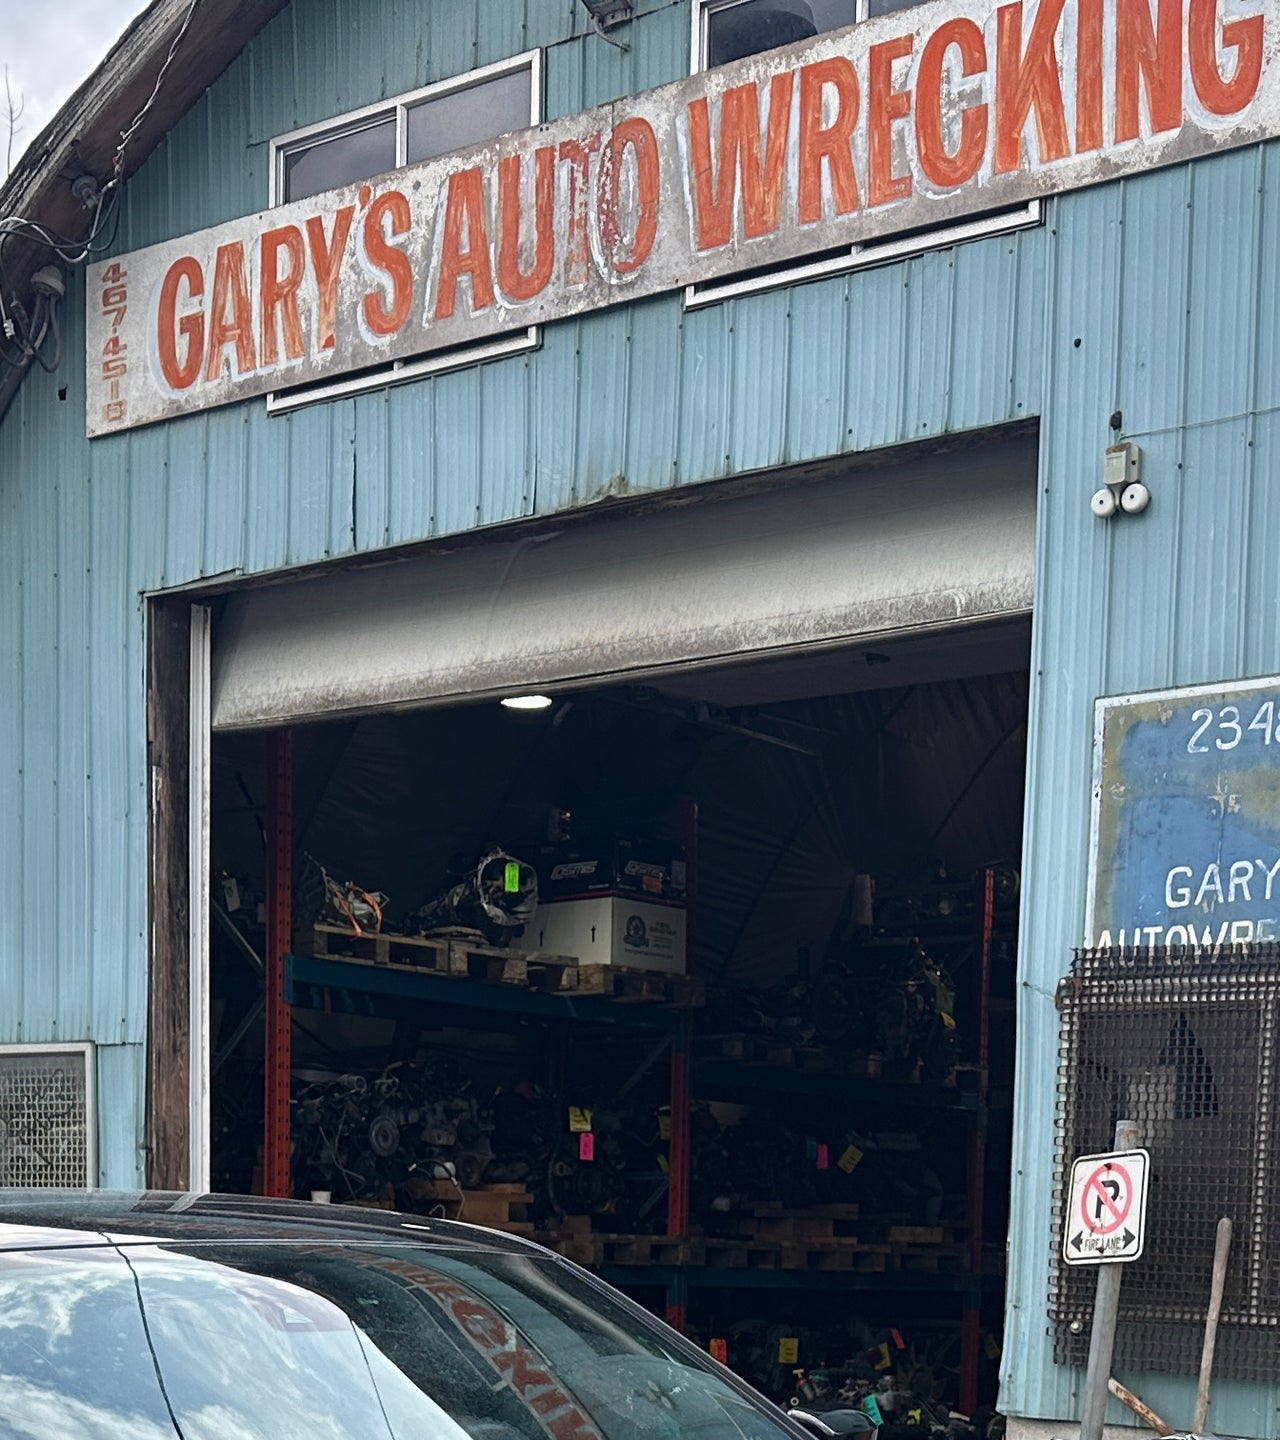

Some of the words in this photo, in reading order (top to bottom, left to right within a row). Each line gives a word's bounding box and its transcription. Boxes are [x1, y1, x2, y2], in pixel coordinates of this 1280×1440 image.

[157, 184, 413, 390] GARY'S
[434, 116, 661, 321] AUTO
[687, 0, 1265, 250] WRECKING
